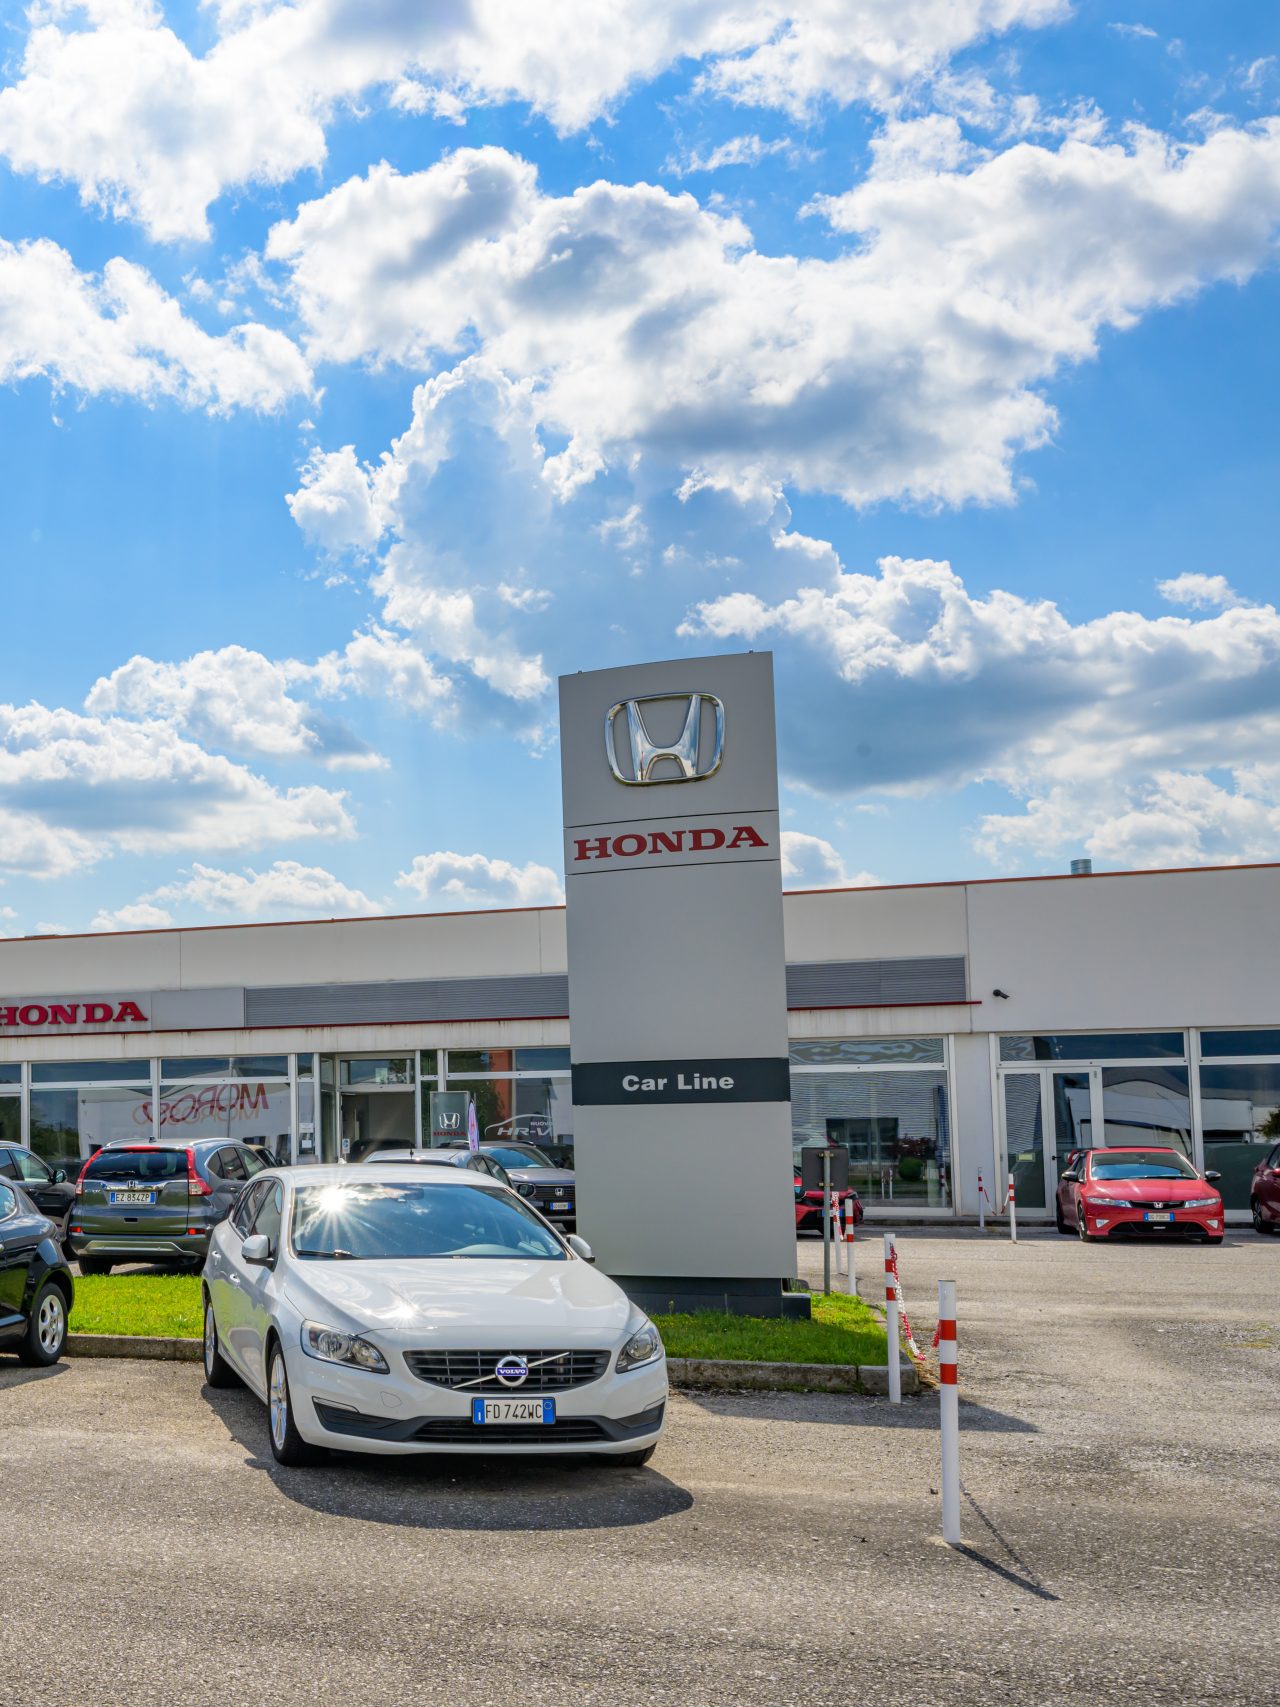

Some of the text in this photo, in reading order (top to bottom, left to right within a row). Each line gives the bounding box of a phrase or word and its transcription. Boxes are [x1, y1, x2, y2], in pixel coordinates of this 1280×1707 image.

[574, 826, 769, 861] HONDA
[622, 1073, 735, 1091] Car Line
[497, 1127, 553, 1136] HR-V
[485, 1404, 501, 1419] FD
[504, 1404, 543, 1419] 742WC
